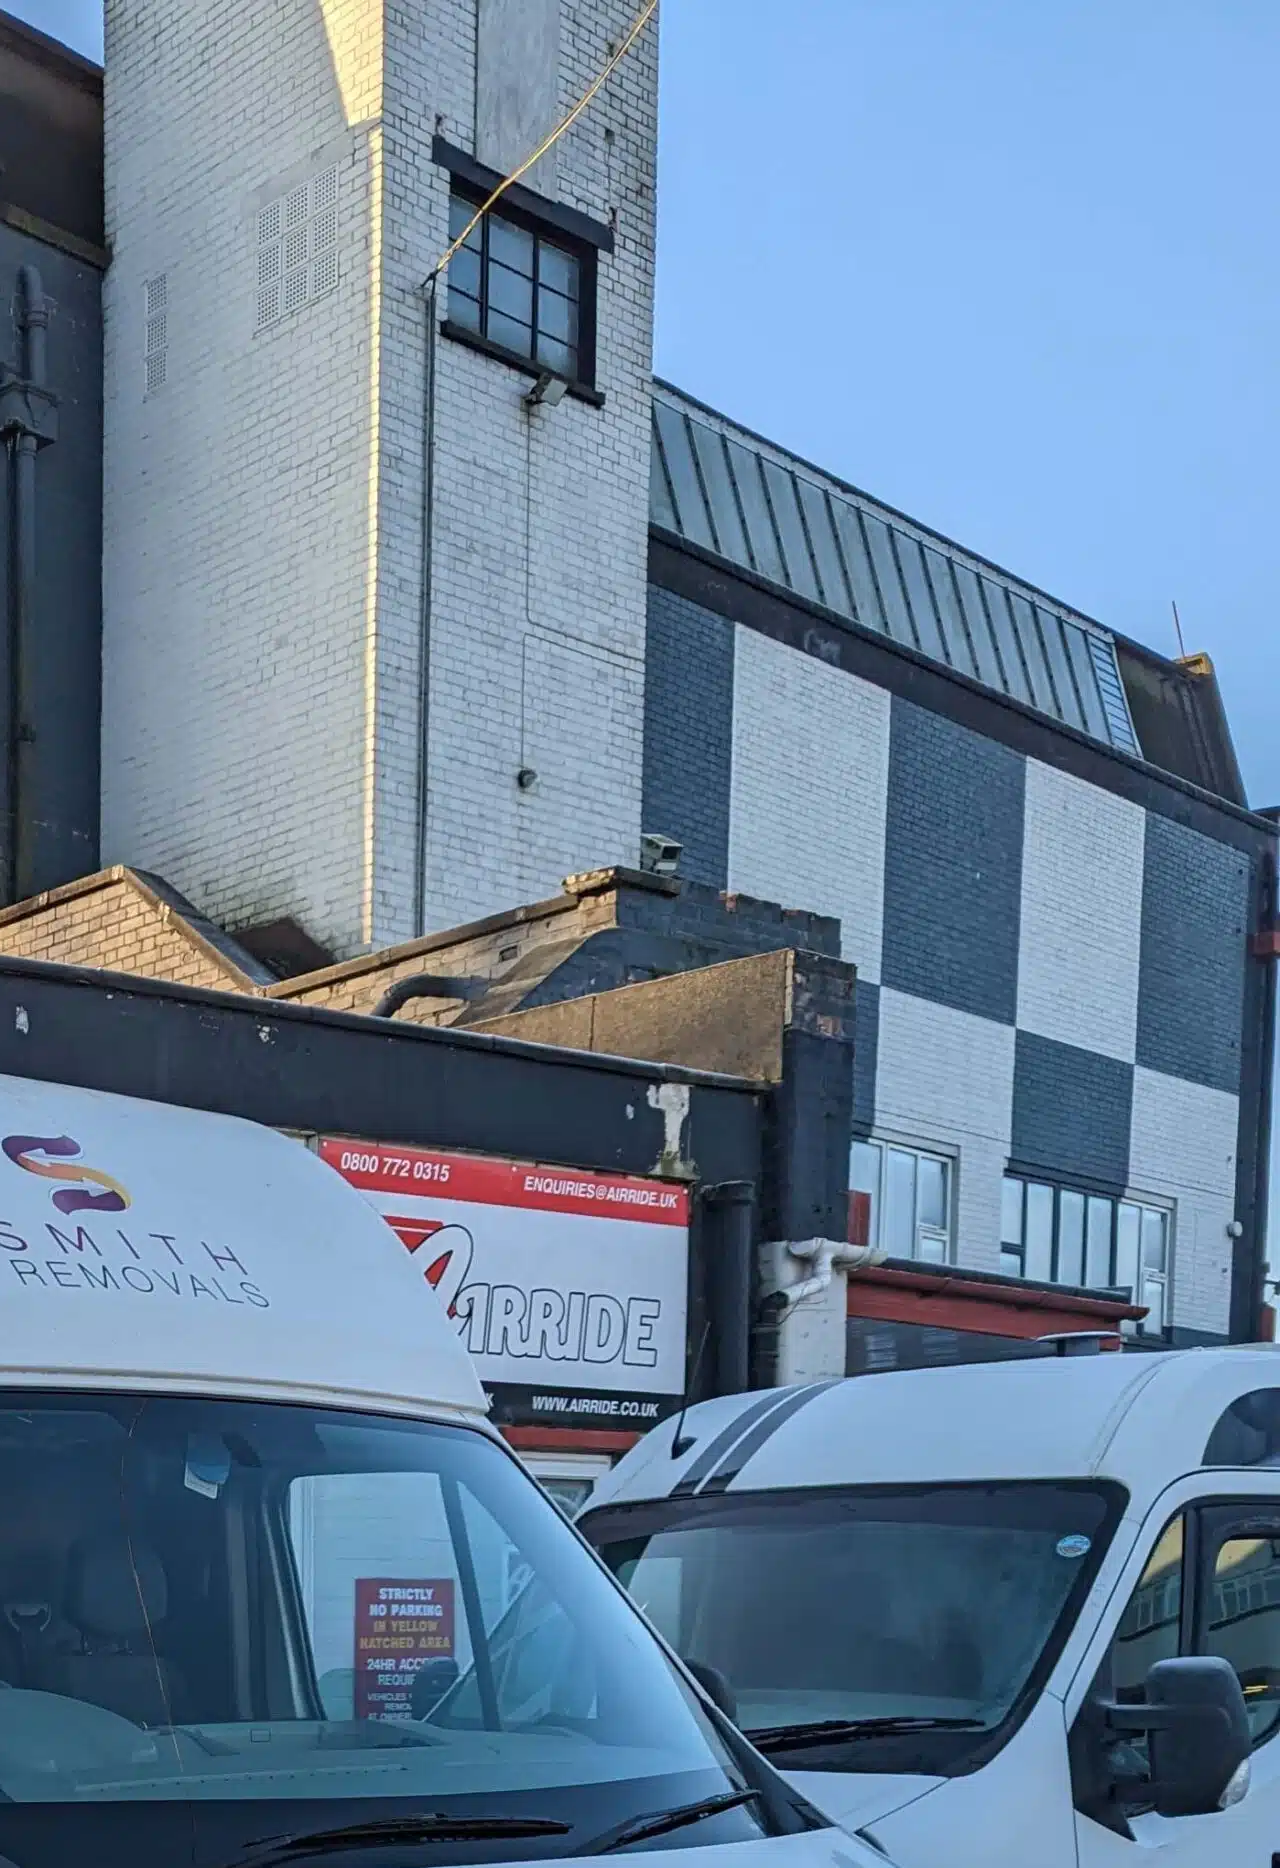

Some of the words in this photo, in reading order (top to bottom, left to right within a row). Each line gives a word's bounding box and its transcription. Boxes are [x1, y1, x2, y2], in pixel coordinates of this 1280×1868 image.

[341, 1151, 379, 1173] 0800
[382, 1157, 410, 1178] 772
[413, 1161, 450, 1183] 0315
[524, 1175, 678, 1209] ENQUIRIES@AIRRIDE.UK
[9, 1259, 270, 1308] REMOVALS
[532, 1395, 658, 1417] WWW.AIRRIDE.CO.UK
[379, 1588, 434, 1601] STRICTLY
[369, 1604, 385, 1617] NO
[391, 1604, 443, 1617] PARKING
[392, 1620, 438, 1632] YELLOW
[367, 1658, 396, 1671] 24HR
